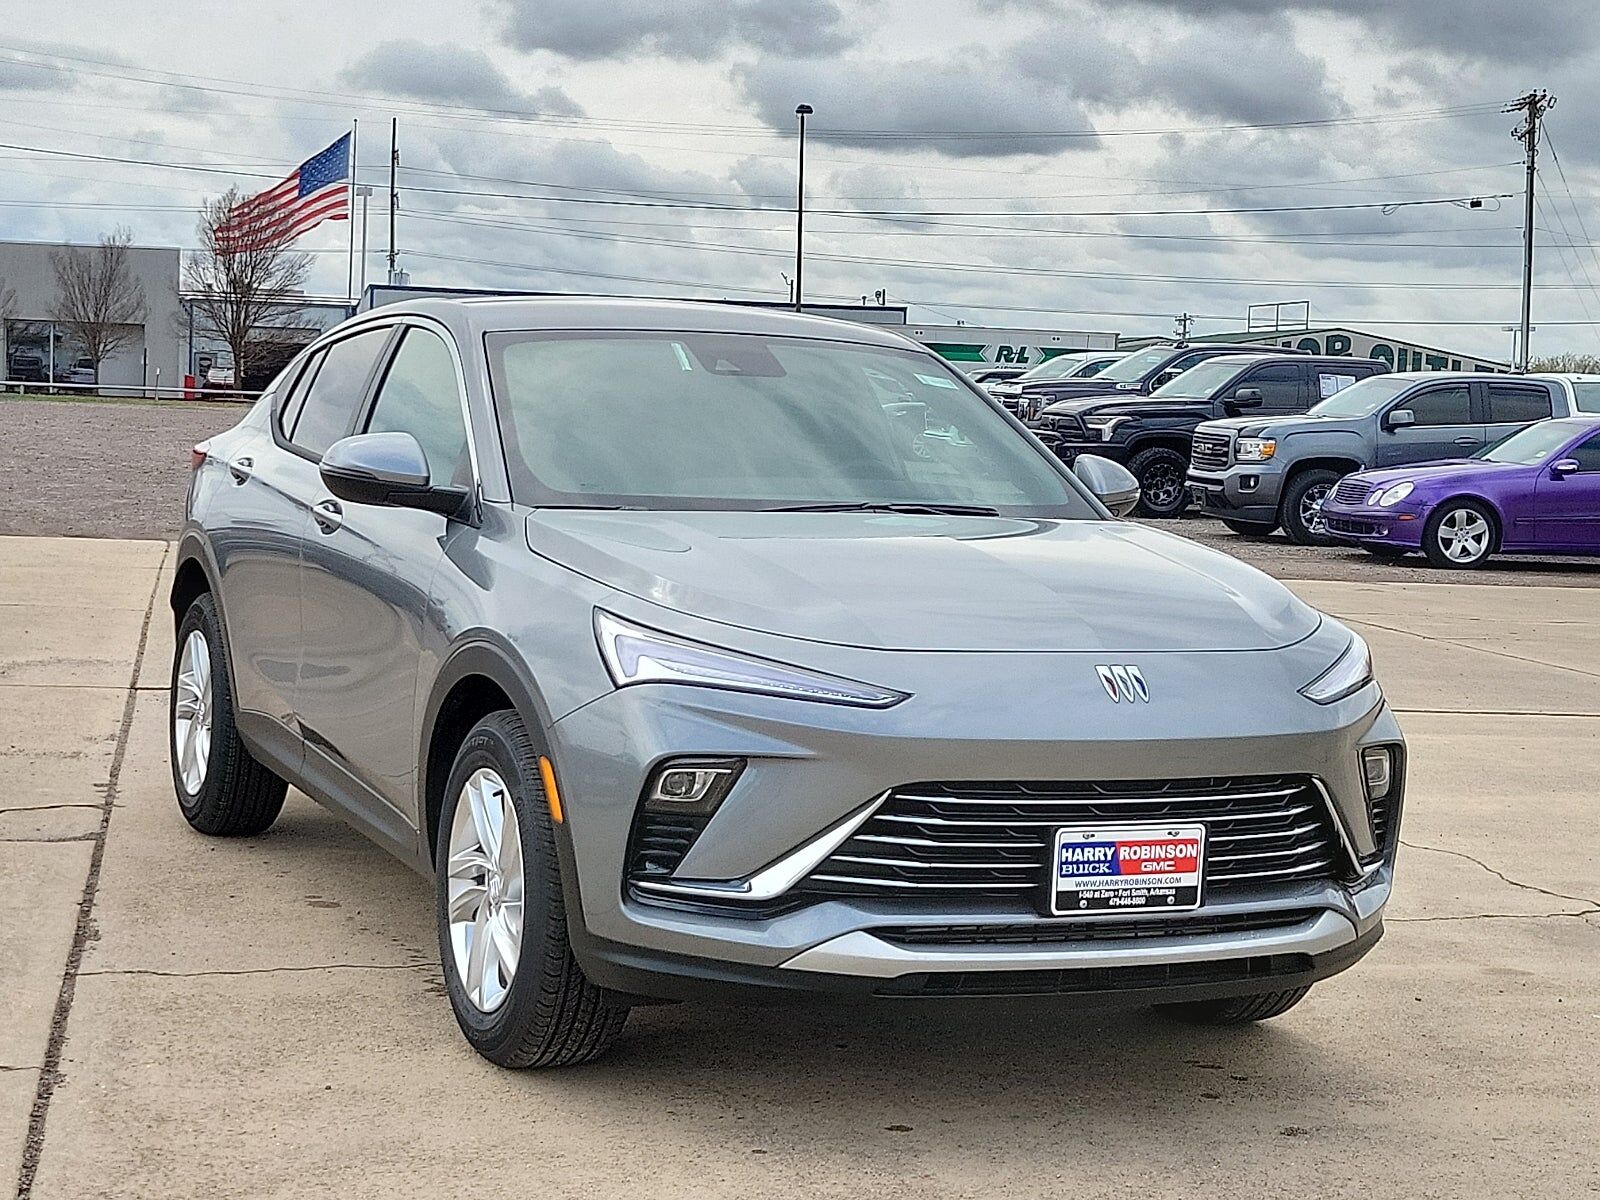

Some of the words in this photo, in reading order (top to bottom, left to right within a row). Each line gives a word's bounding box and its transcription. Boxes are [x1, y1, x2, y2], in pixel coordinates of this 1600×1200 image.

[1061, 846, 1116, 862] HARRY
[1119, 843, 1198, 860] ROBINSON
[1061, 863, 1112, 875] BUICK
[1141, 861, 1176, 872] GMC
[1075, 876, 1182, 888] WWW.HARRYROBINSON.COM
[1118, 888, 1130, 897] Fort
[1150, 887, 1176, 896] Arkansas
